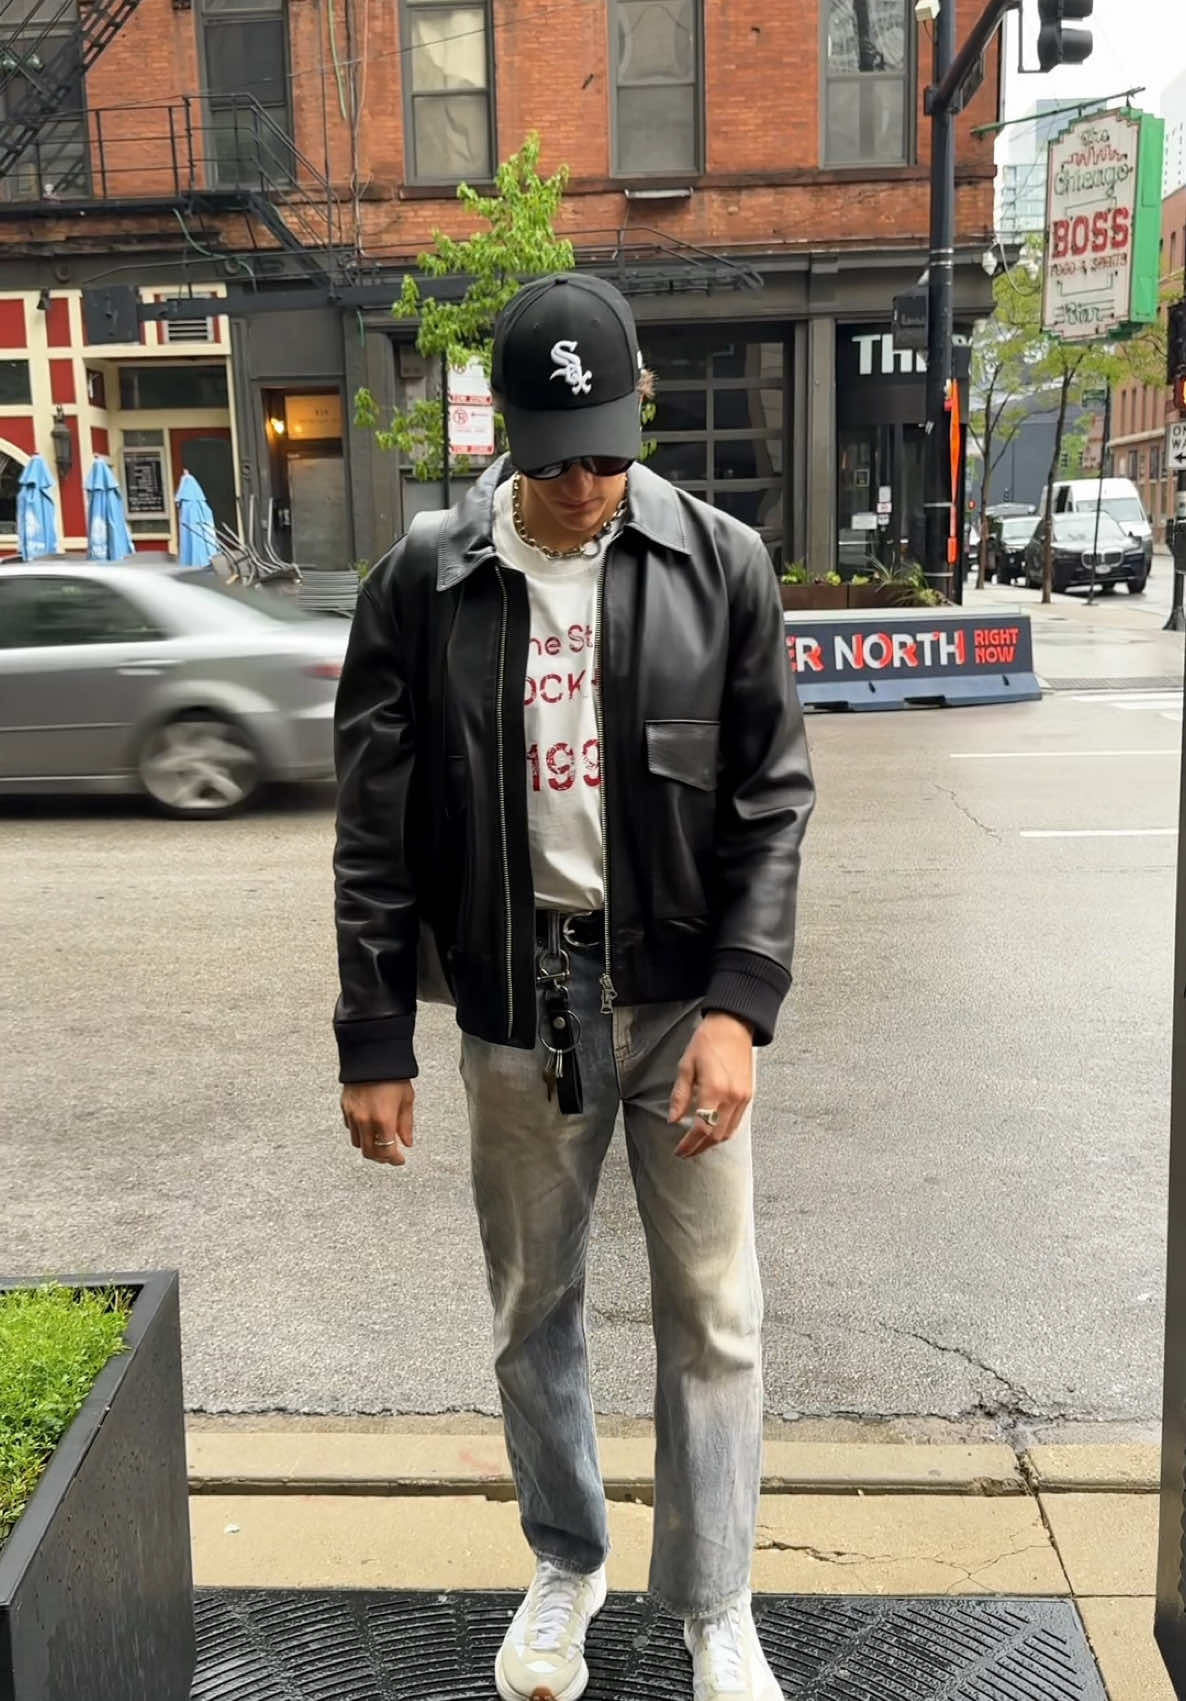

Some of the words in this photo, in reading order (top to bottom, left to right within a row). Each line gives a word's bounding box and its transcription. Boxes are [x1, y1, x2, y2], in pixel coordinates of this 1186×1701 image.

[1055, 163, 1134, 197] Chicago
[1052, 207, 1129, 258] BOSS
[550, 341, 593, 395] Sox
[834, 628, 966, 671] NORTH
[973, 627, 1019, 646] RIGHT
[975, 645, 1015, 664] NOW
